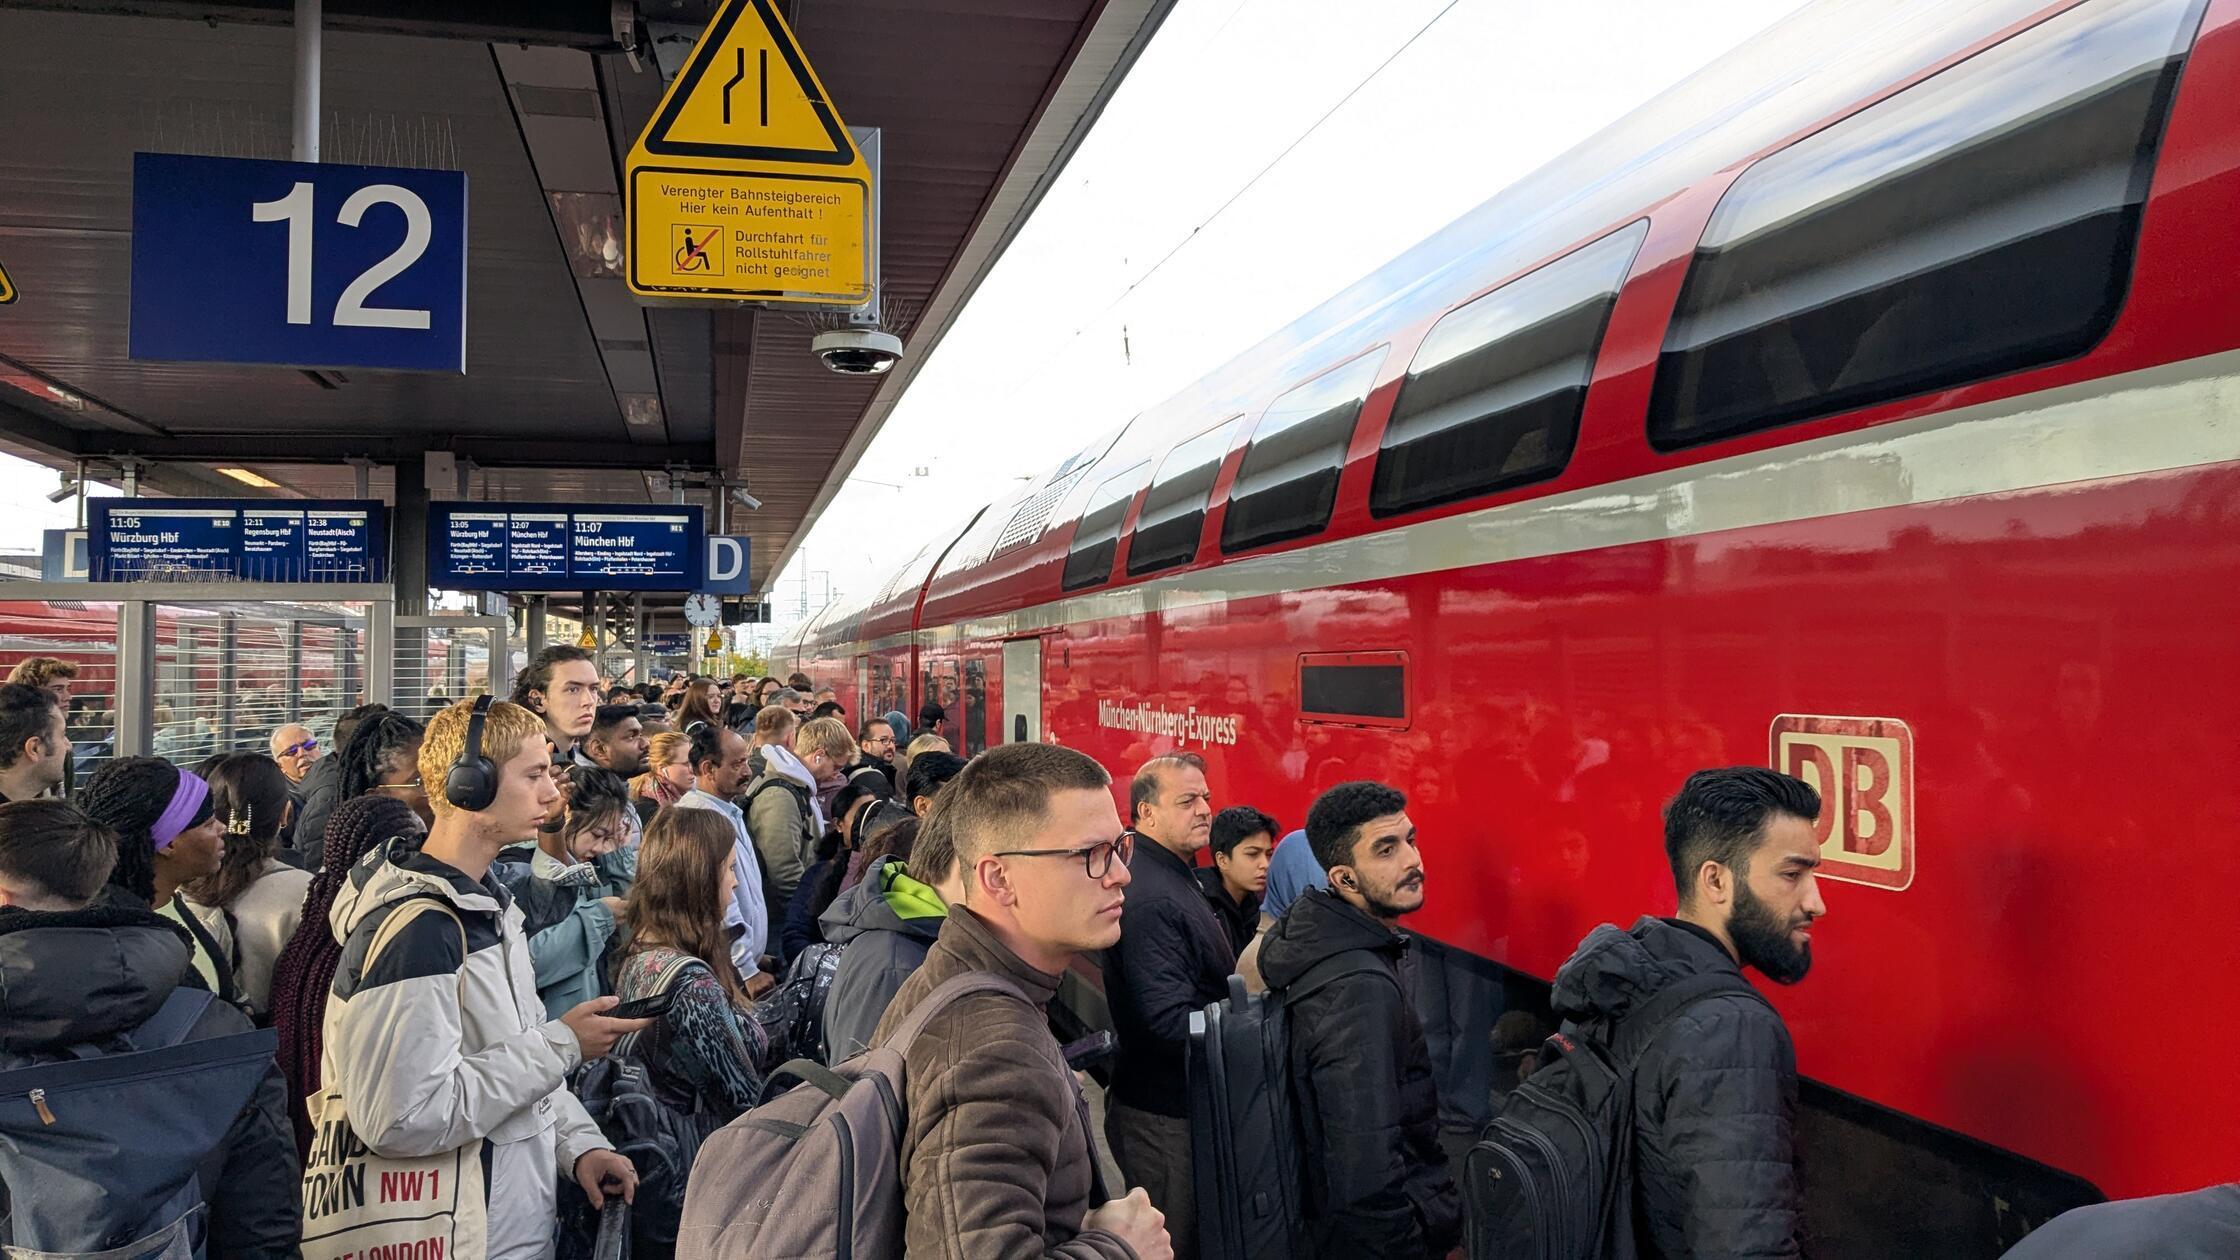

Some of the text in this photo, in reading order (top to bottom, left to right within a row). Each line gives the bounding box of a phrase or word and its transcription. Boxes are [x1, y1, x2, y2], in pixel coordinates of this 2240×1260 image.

[661, 184, 841, 205] Verengter Bahnsteigbereich
[680, 202, 706, 214] Hier
[713, 204, 738, 216] kein
[746, 205, 813, 219] Aufenthalt
[736, 230, 828, 246] Durchfahrt für
[253, 182, 432, 329] 12
[736, 247, 831, 262] Rollstuhlfahrer
[736, 263, 831, 279] nicht geeignet
[110, 518, 141, 528] 11:05
[574, 522, 602, 533] 11:07
[110, 532, 179, 545] Würzburg Hbf
[244, 528, 279, 536] Regensburg
[450, 531, 478, 539] Würzburg
[575, 536, 634, 547] München Hbf
[709, 537, 743, 580] D
[1099, 699, 1237, 749] München-Nürnberg-Express
[1788, 743, 1894, 856] DB
[380, 1169, 439, 1203] NW1
